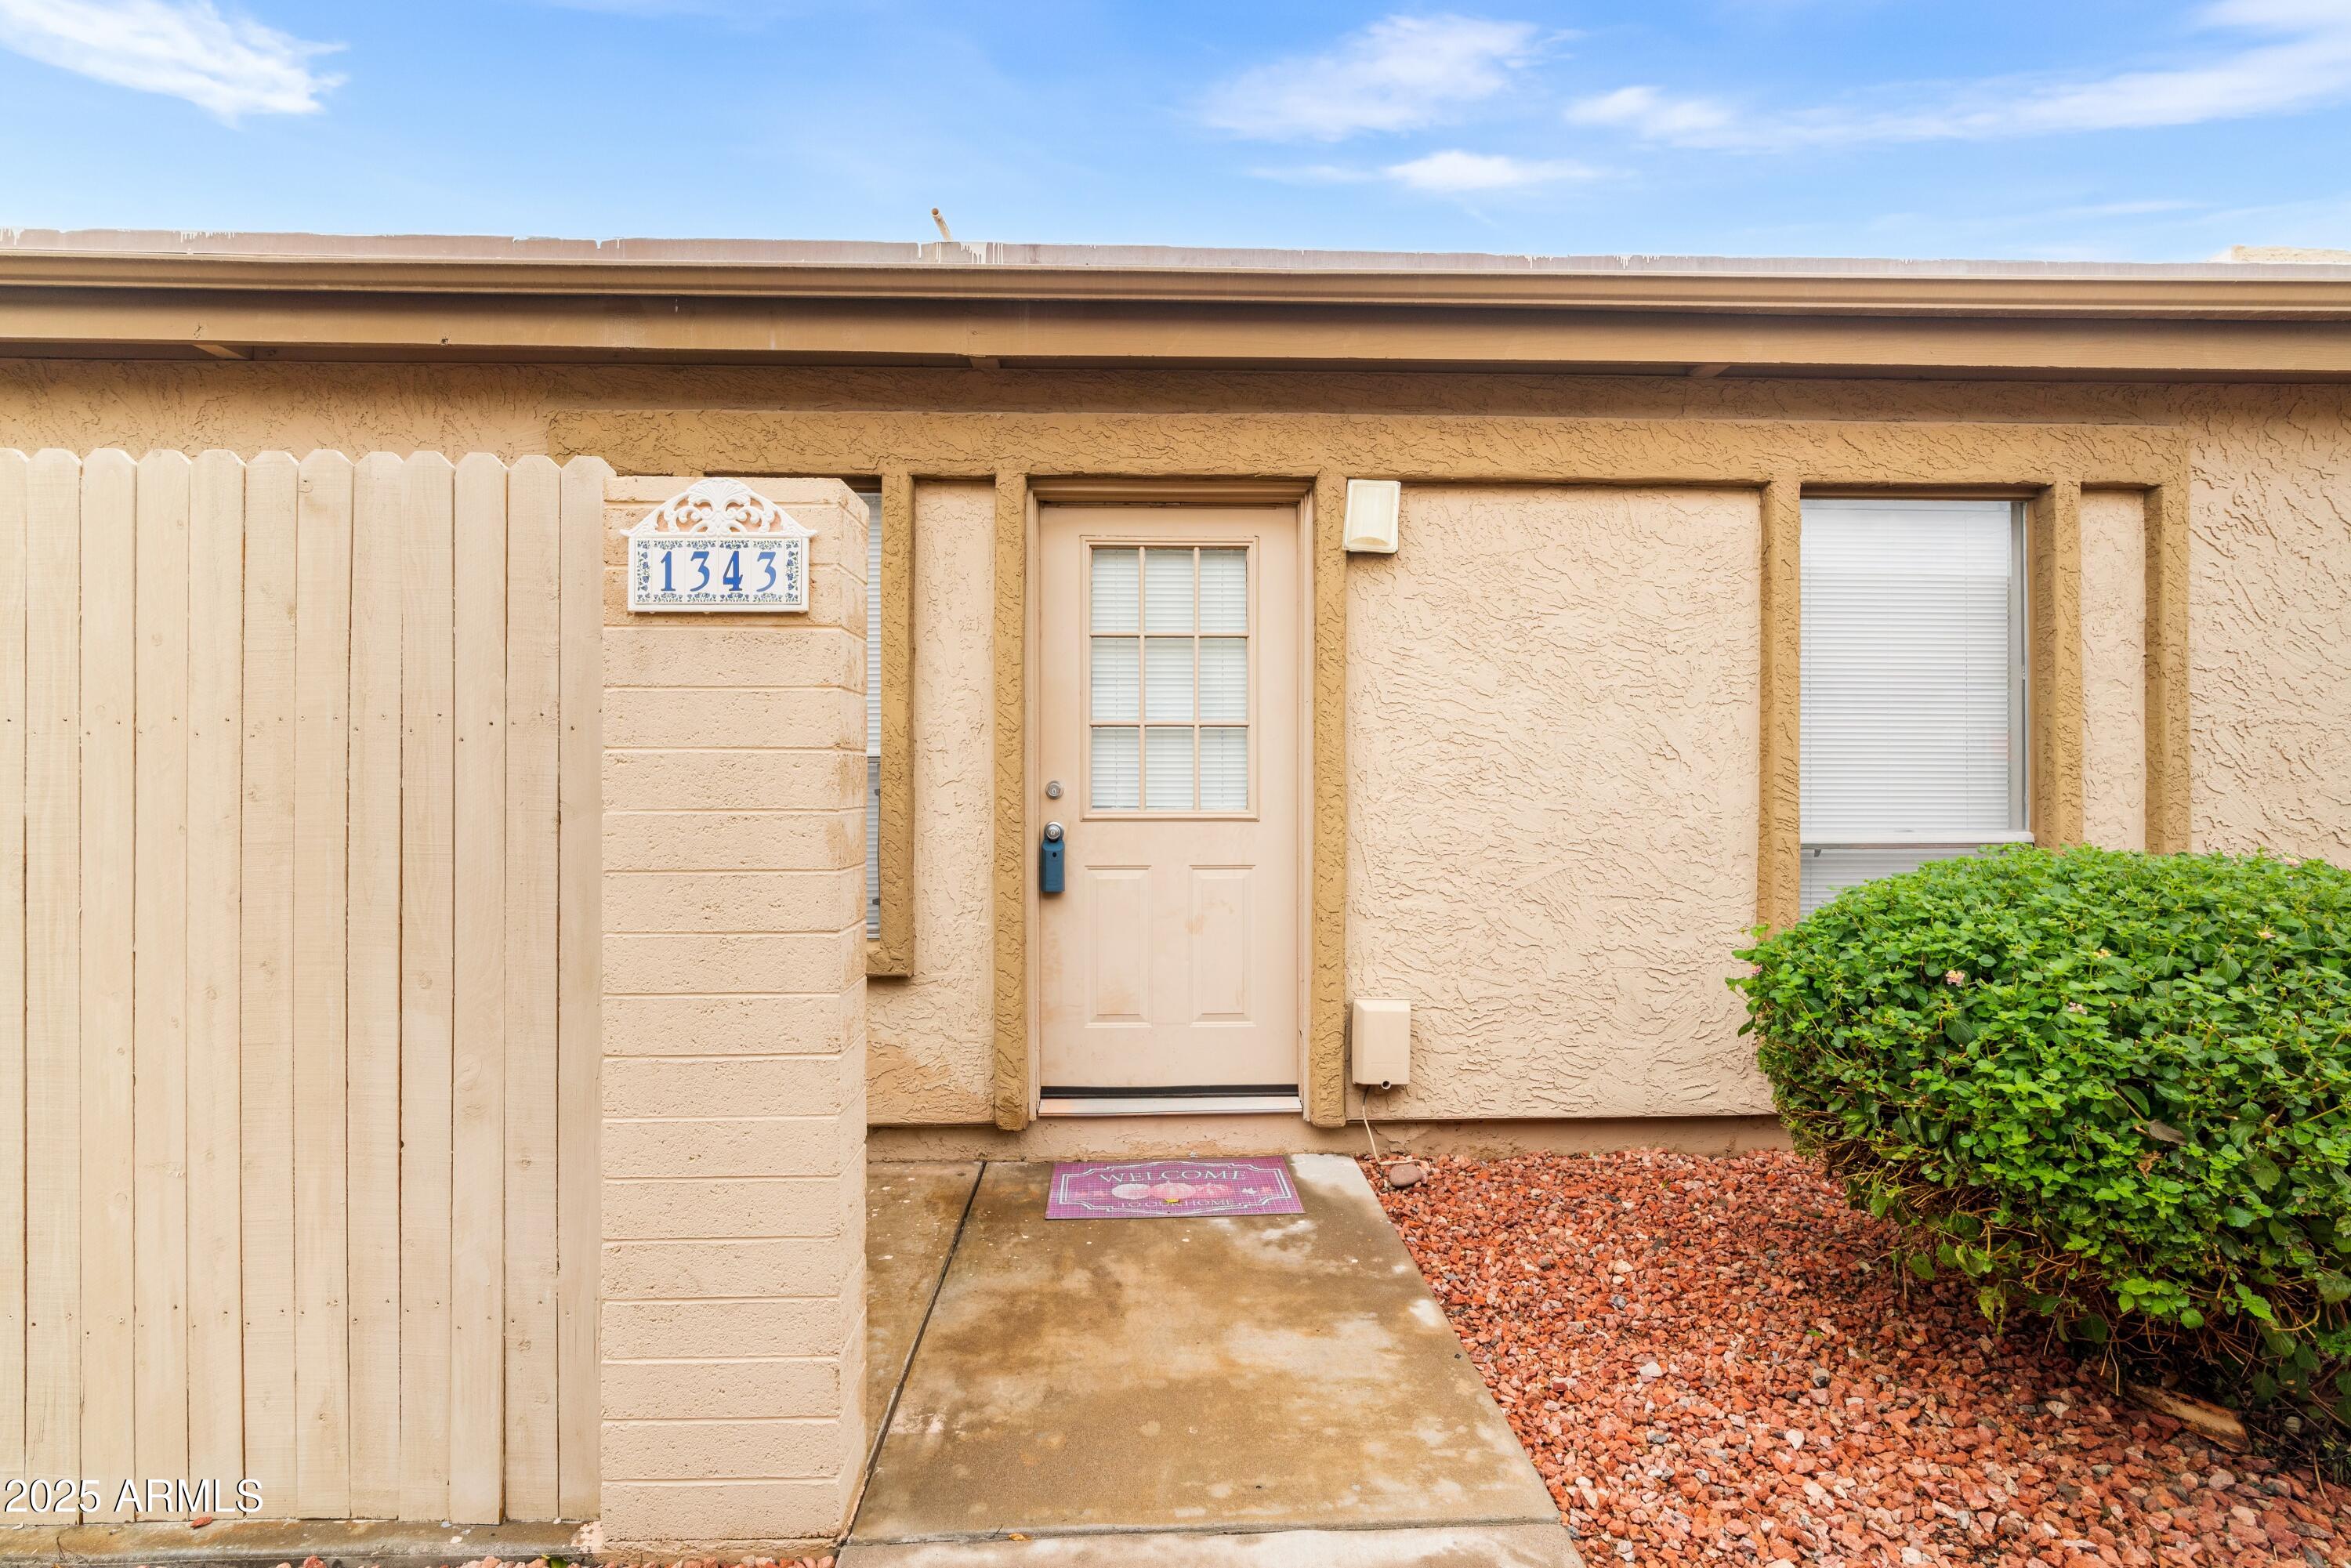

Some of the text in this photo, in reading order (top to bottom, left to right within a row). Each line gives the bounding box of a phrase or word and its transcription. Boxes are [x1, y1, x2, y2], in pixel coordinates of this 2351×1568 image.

[661, 550, 777, 592] 1343
[1099, 1169, 1246, 1183] WELCOME
[1184, 1199, 1235, 1208] HOME
